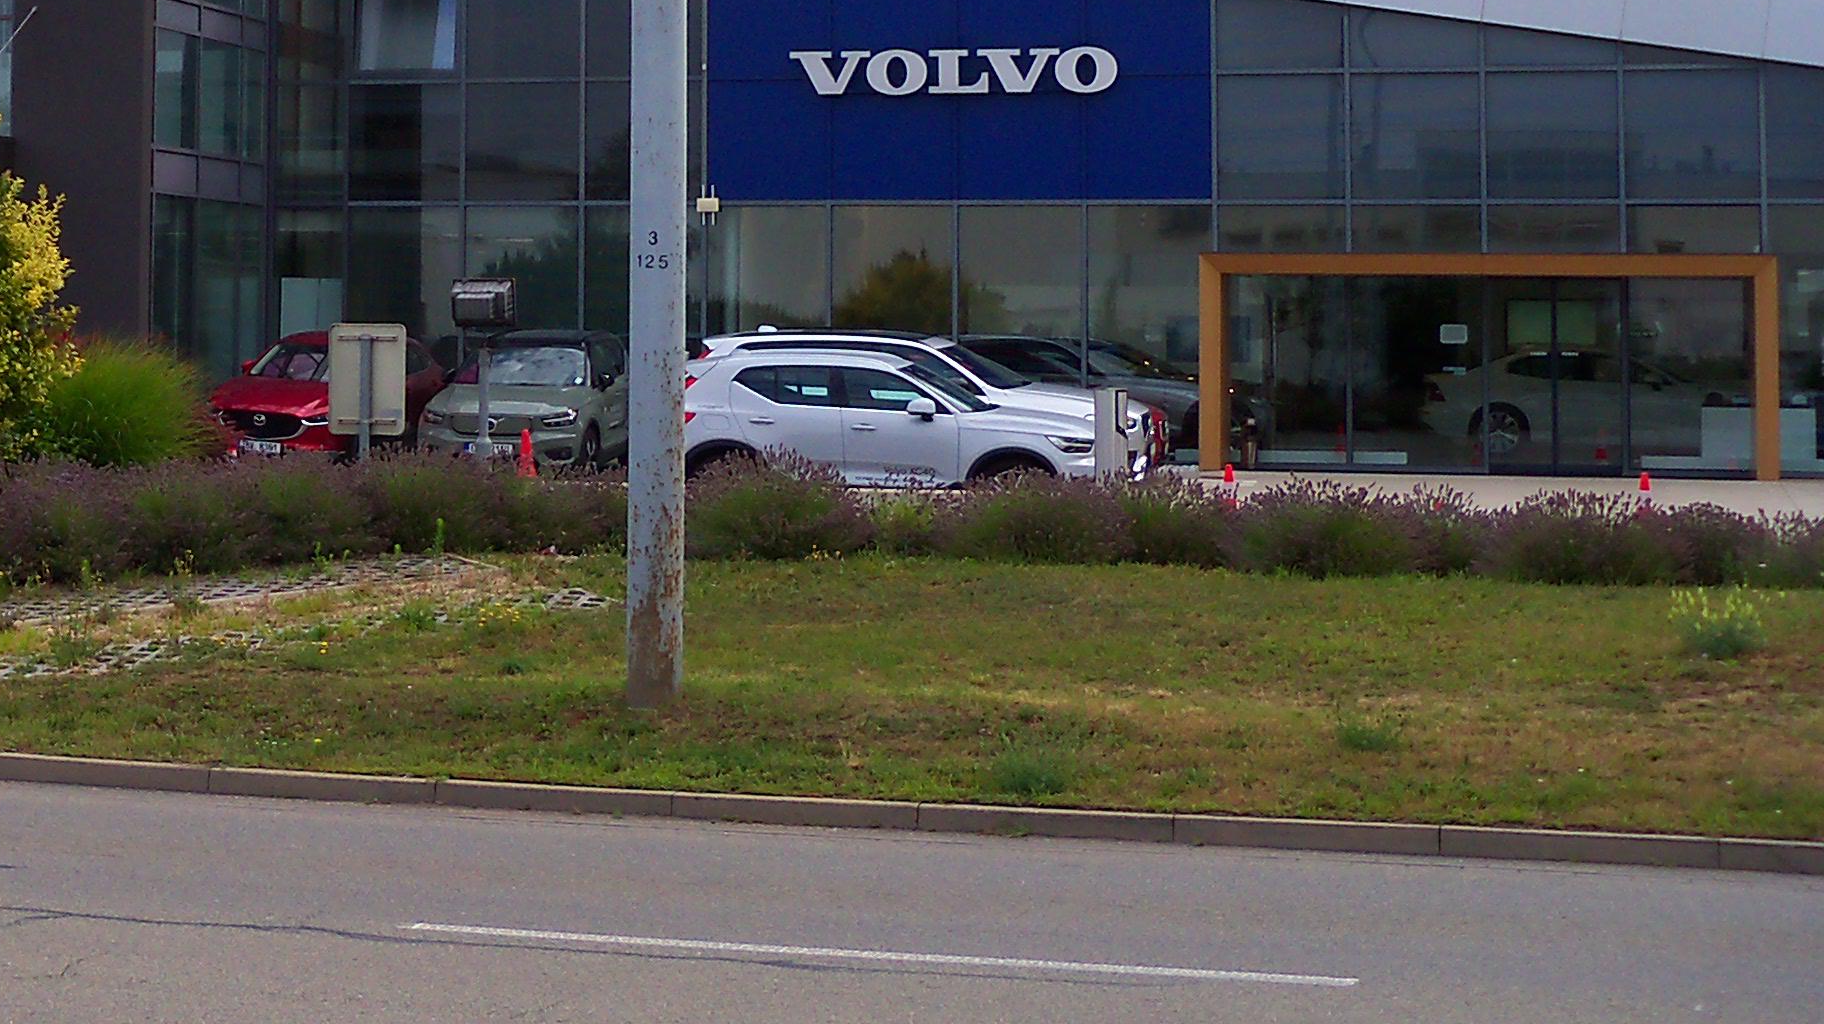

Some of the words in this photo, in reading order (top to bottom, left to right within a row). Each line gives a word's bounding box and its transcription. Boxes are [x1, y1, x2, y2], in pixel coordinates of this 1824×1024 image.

[789, 46, 1118, 95] VOLVO
[648, 230, 658, 246] 3
[637, 254, 669, 269] 125
